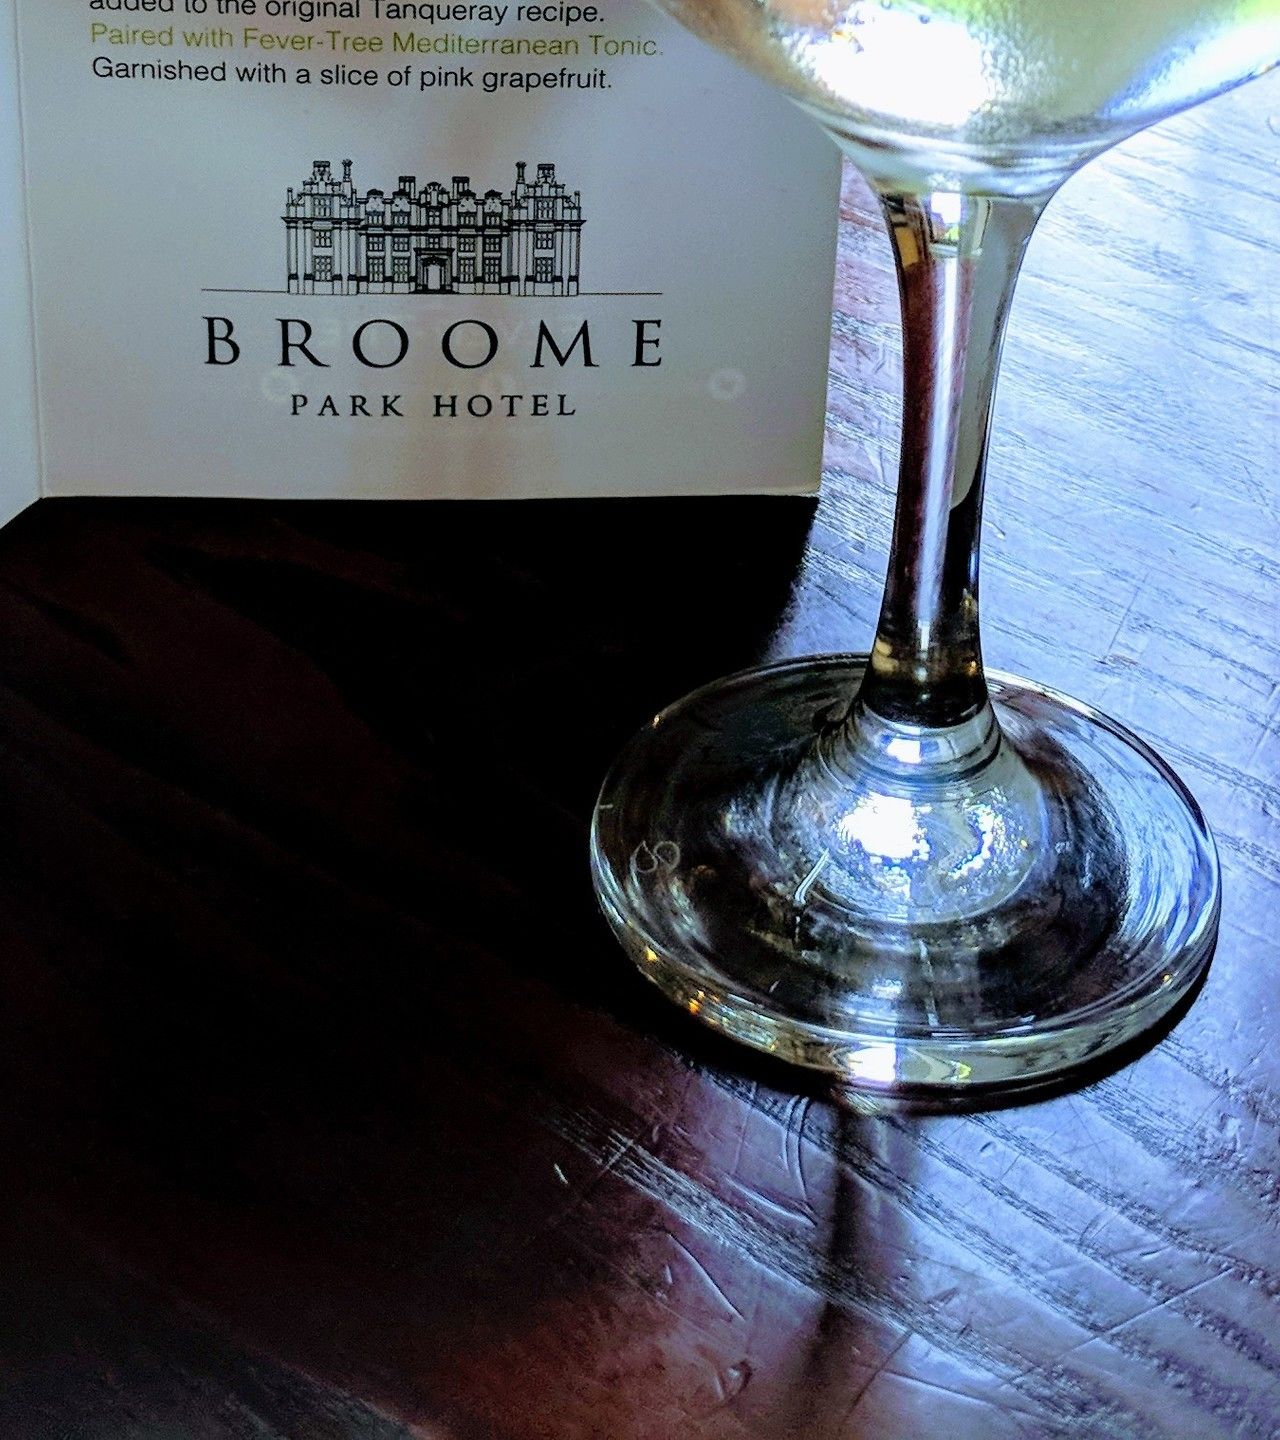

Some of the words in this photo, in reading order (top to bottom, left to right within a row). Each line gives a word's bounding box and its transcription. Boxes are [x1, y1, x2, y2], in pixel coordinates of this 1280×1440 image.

[517, 0, 604, 27] recipe.
[91, 22, 174, 47] Paired
[182, 28, 233, 48] with
[243, 27, 383, 53] Fever-Tree
[392, 31, 579, 56] Mediterranean
[588, 34, 664, 56] Tonic.
[92, 56, 226, 82] Garnished
[235, 62, 286, 84] with
[295, 68, 312, 85] a
[320, 64, 378, 86] slice
[386, 65, 412, 87] of
[420, 66, 474, 92] pink
[482, 67, 612, 93] grapefruit.
[202, 316, 662, 370] BROOME
[291, 393, 404, 417] PARK
[433, 393, 576, 418] HOTEL
